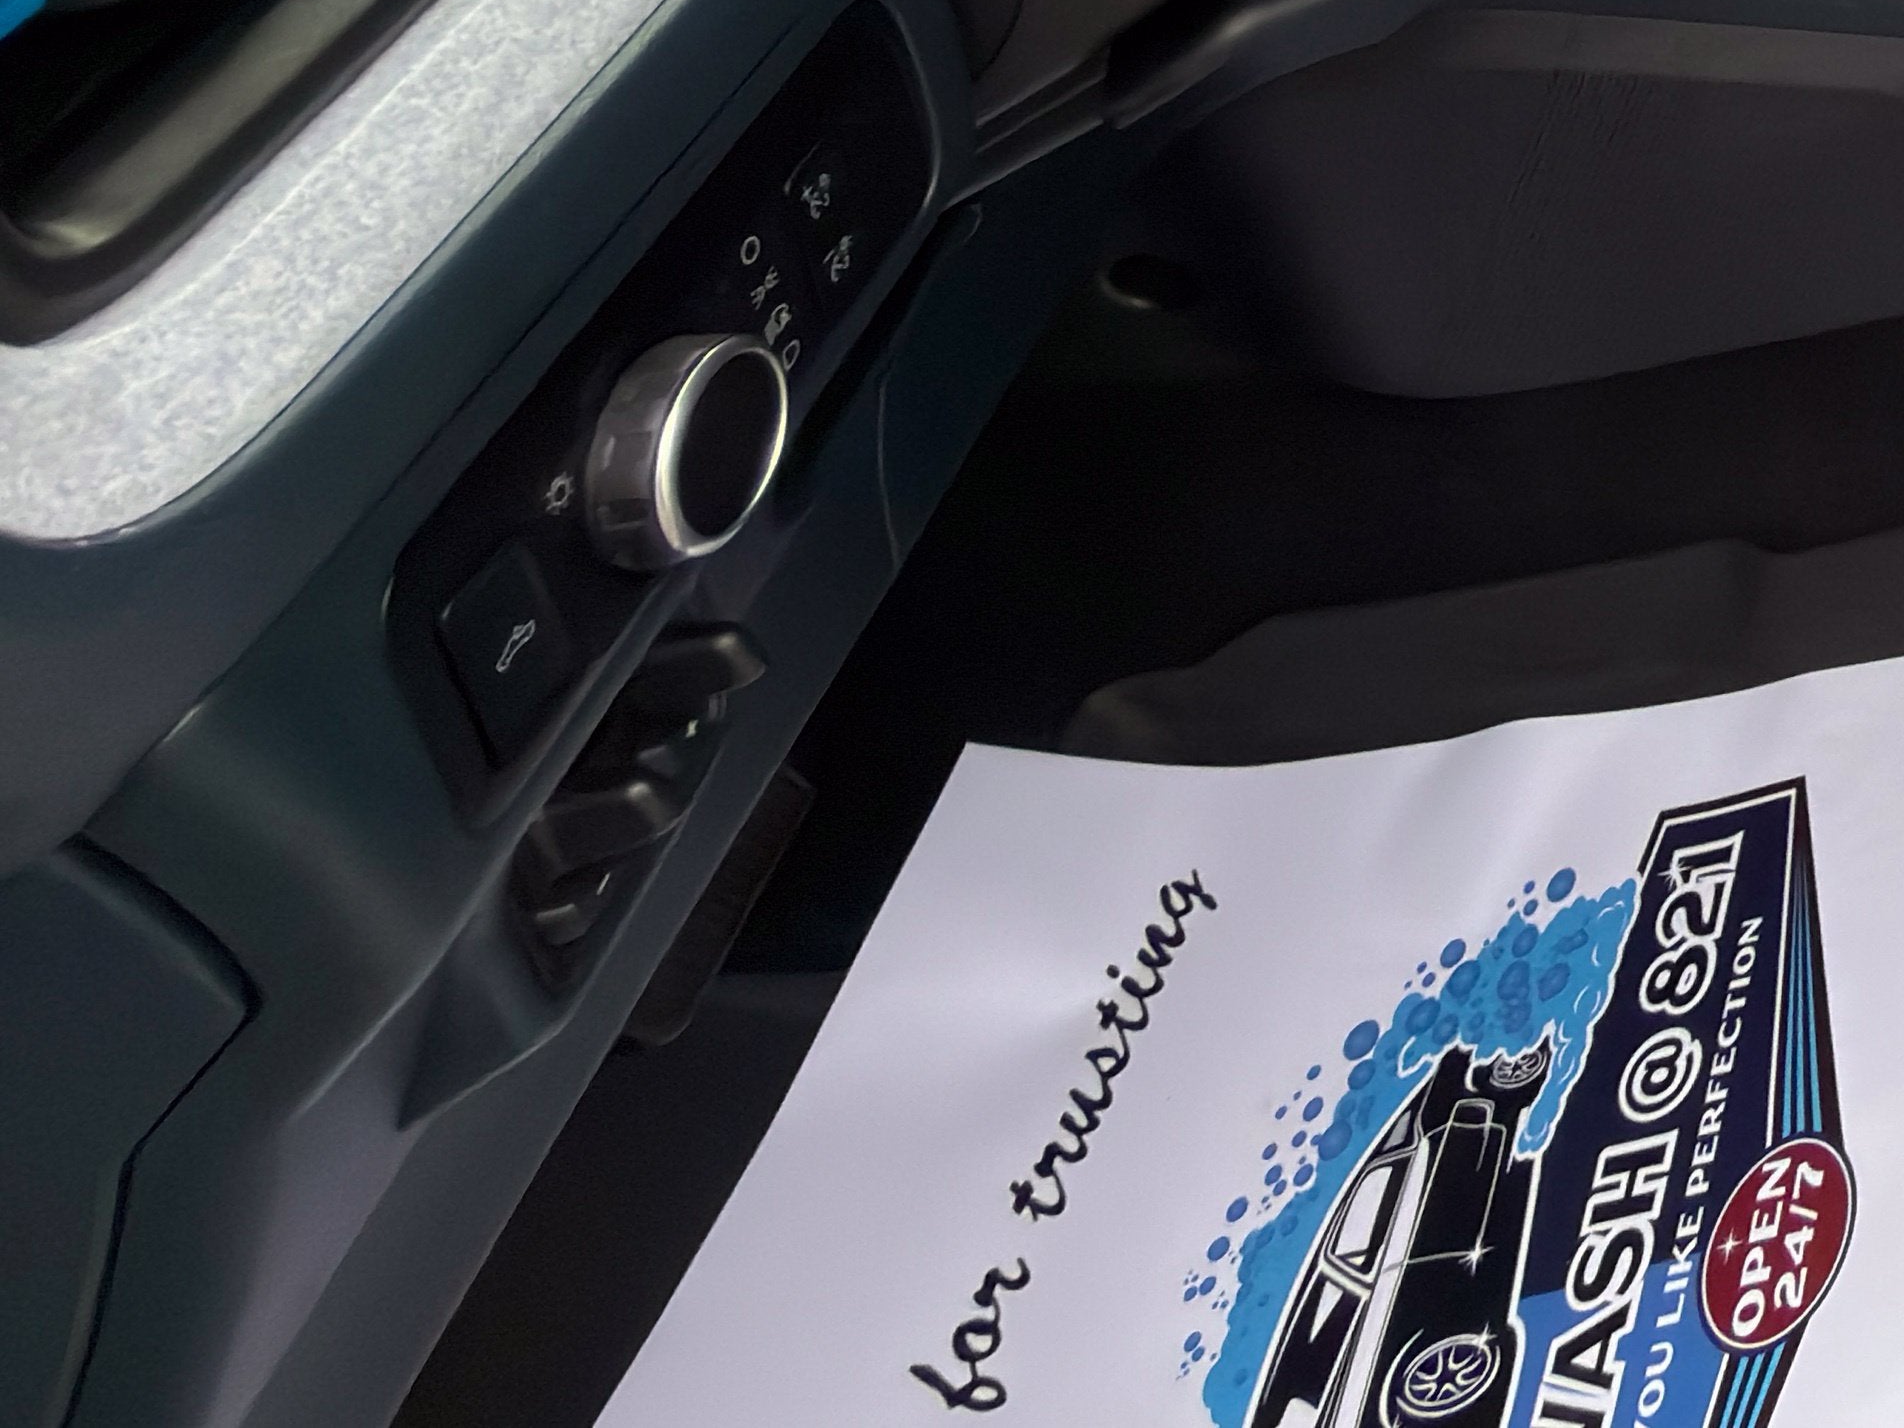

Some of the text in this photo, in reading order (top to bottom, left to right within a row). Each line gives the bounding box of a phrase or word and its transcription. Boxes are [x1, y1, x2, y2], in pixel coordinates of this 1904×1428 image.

[1640, 829, 1746, 1016] 821
[909, 868, 1218, 1412] for trusting
[1619, 1024, 1704, 1124] @
[1634, 916, 1764, 1428] OU LIKE PERFECTION
[1733, 1156, 1792, 1338] OPEN
[1772, 1163, 1825, 1310] 24/7
